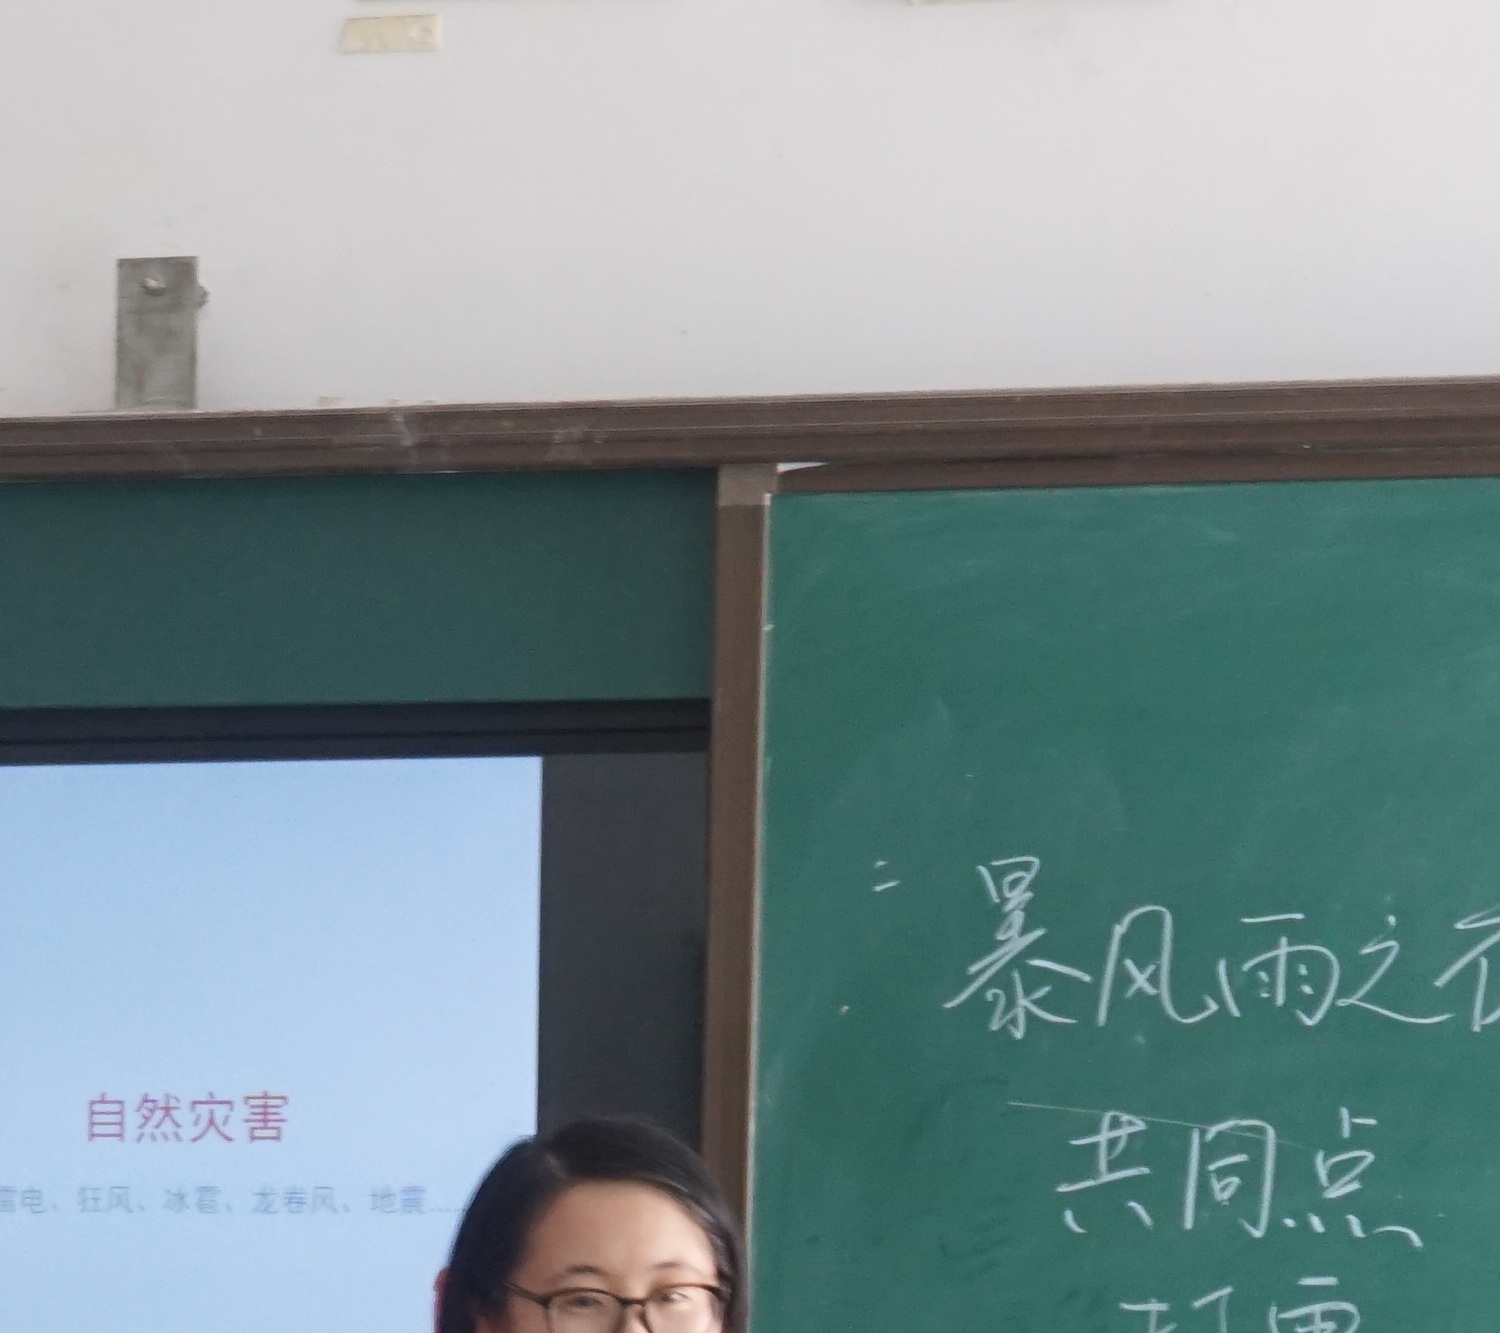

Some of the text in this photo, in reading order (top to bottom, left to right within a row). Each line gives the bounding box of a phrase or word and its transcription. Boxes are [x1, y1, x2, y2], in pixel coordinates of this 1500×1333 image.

[86, 1090, 290, 1145] 自然灾害
[1056, 1106, 1423, 1247] 共同点
